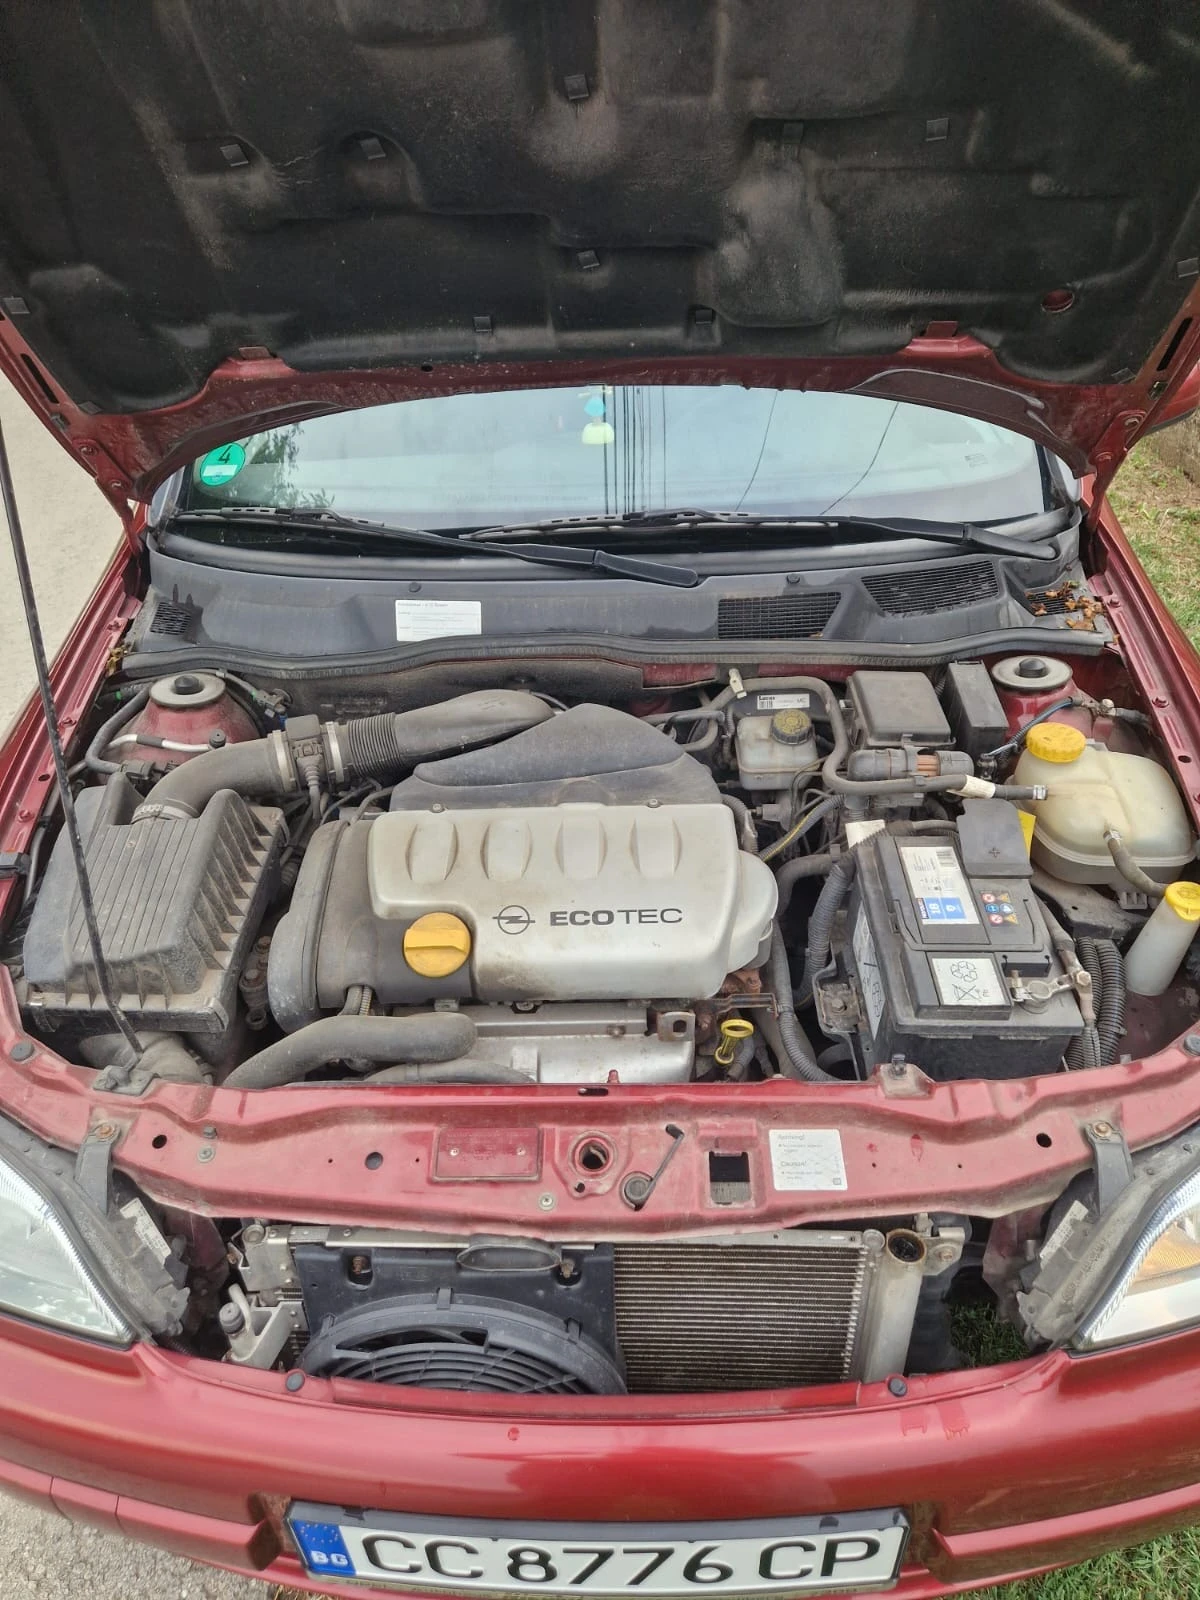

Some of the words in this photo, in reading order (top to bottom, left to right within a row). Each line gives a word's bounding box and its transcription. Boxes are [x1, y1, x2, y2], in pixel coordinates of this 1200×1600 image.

[217, 445, 232, 464] 4
[550, 908, 683, 926] ECOTEC
[311, 1550, 348, 1566] BG
[362, 1534, 484, 1579] CC
[507, 1544, 733, 1586] 8776
[758, 1536, 881, 1580] CP
